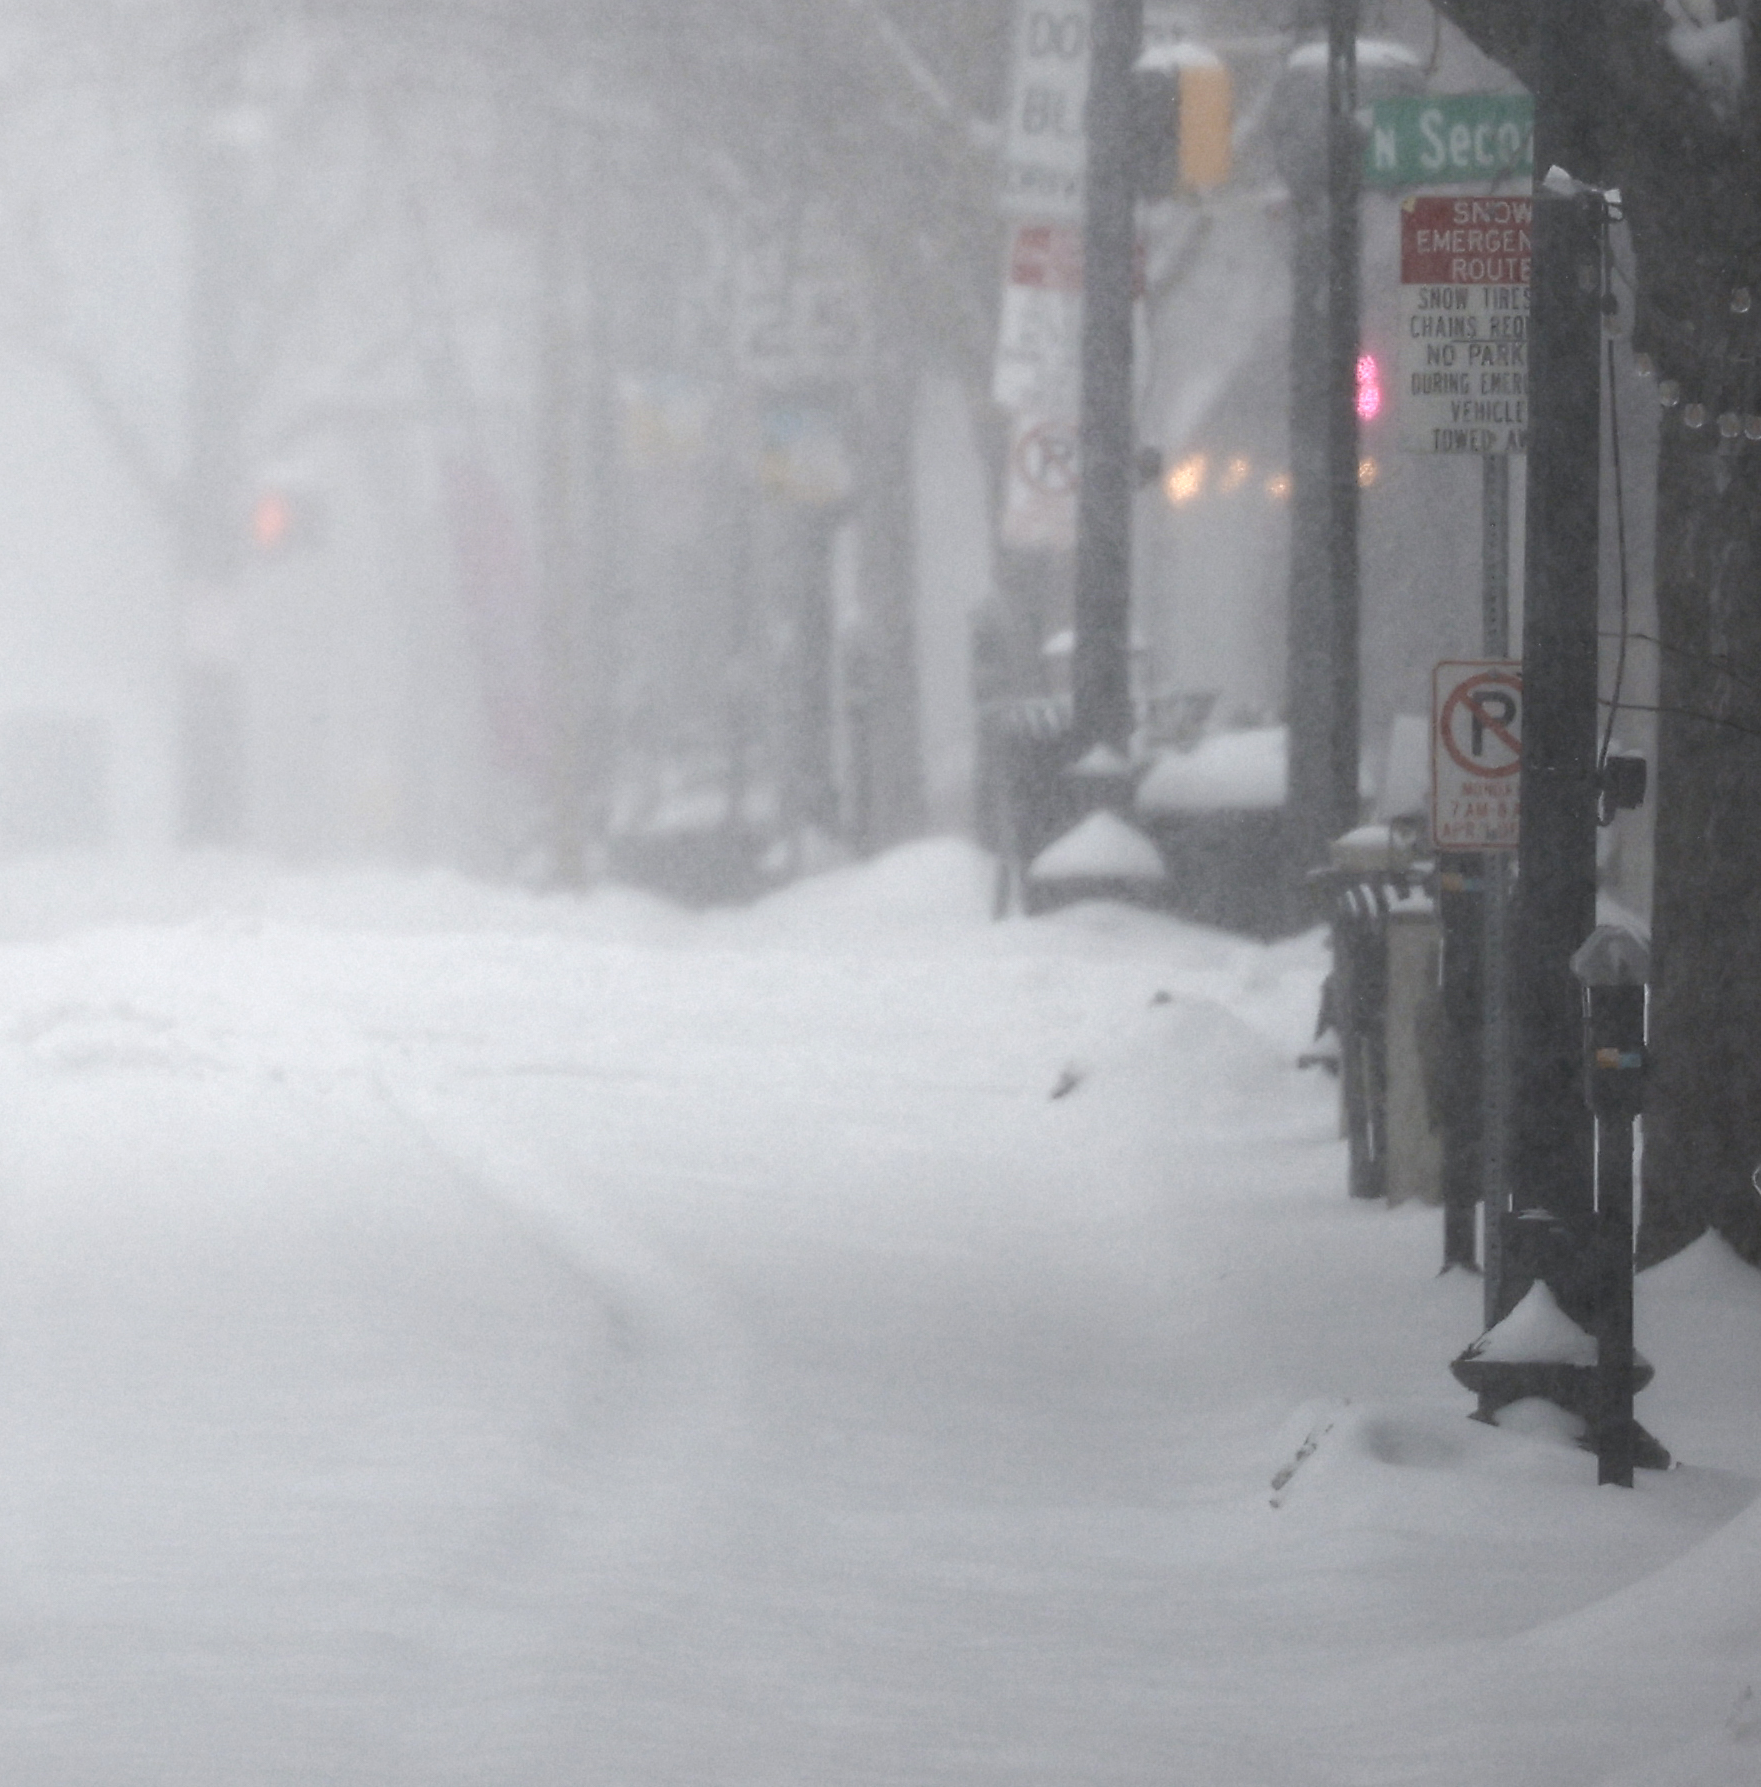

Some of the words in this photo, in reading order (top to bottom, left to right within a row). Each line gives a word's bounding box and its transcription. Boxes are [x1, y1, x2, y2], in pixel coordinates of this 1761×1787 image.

[1375, 127, 1396, 169] N
[1453, 200, 1532, 224] SNOW
[1416, 228, 1532, 254] EMERGEN
[1451, 257, 1531, 282] ROUTE
[1418, 287, 1468, 311] SNOW
[1482, 286, 1531, 311] TIRES
[1410, 315, 1477, 339] CHAINS
[1489, 315, 1529, 340] REQ
[1426, 343, 1455, 367] NO
[1468, 343, 1524, 368] PARK
[1411, 372, 1469, 395] DURING
[1432, 428, 1494, 453] TOWED
[1461, 781, 1520, 797] MONDA
